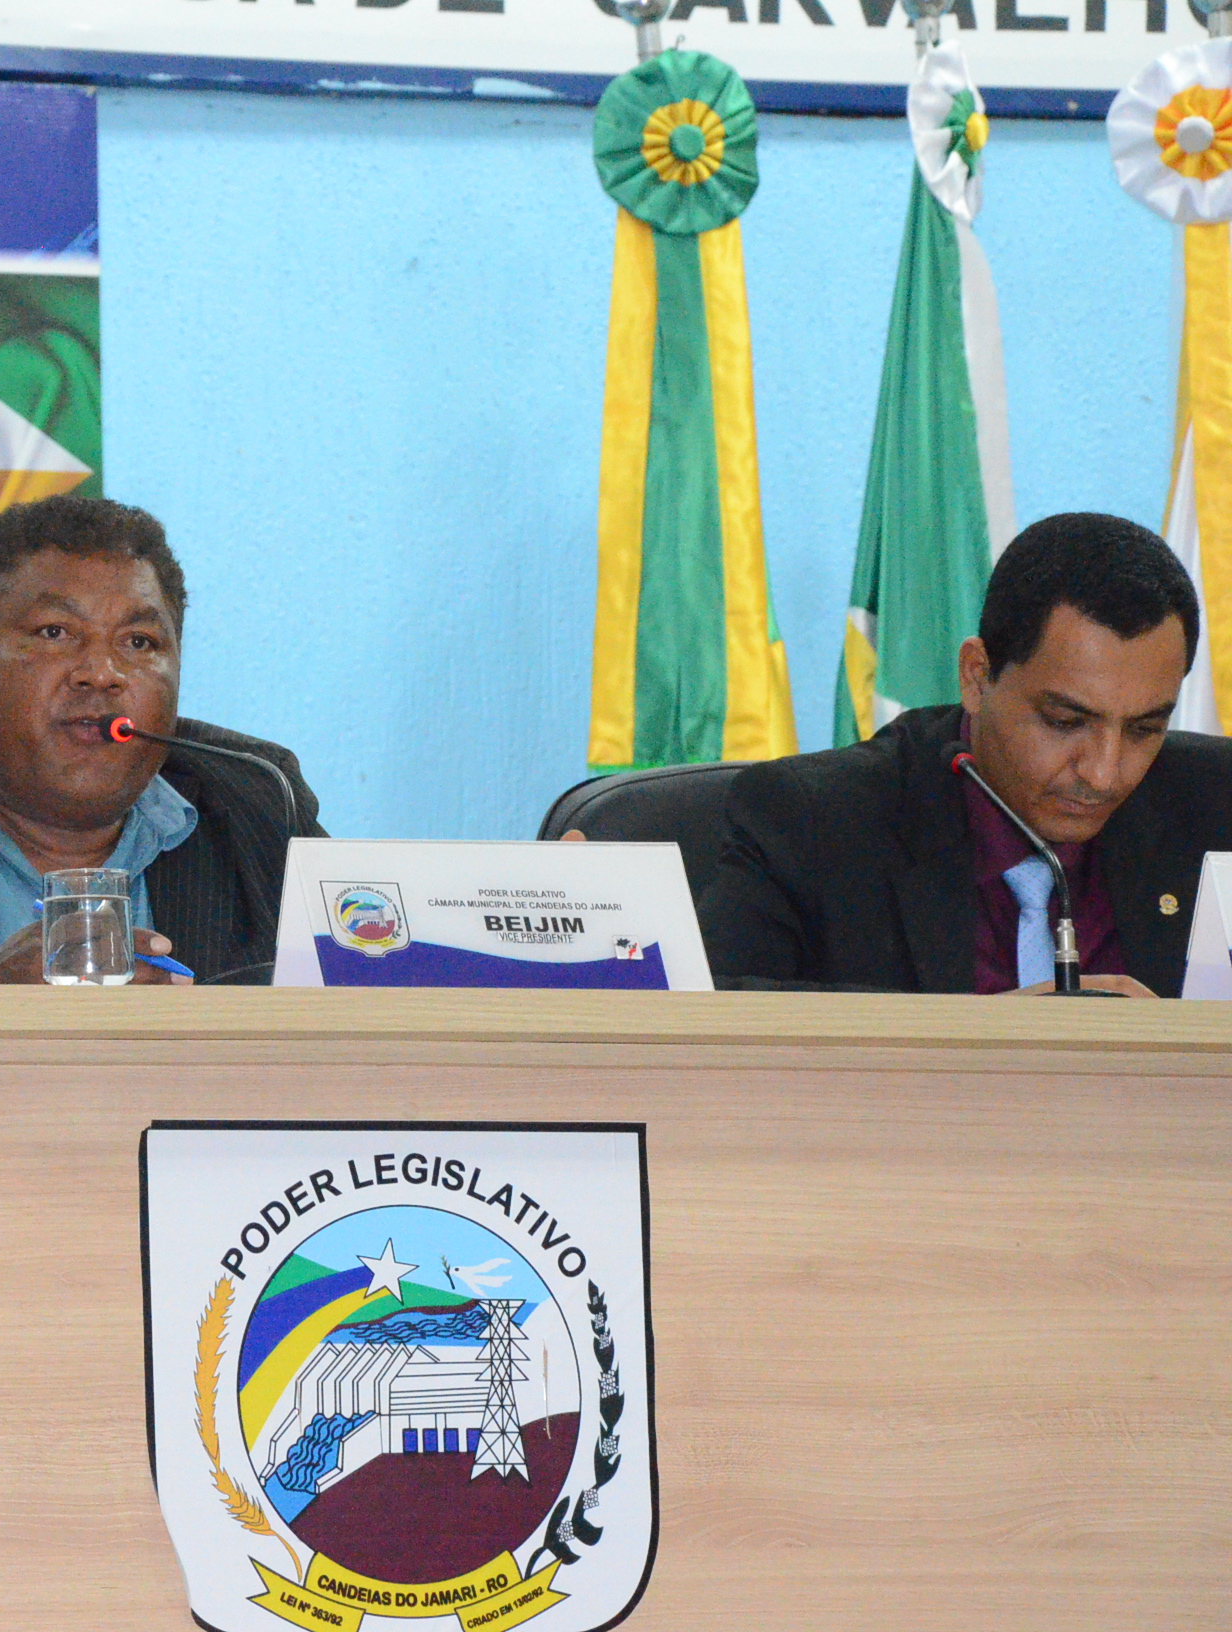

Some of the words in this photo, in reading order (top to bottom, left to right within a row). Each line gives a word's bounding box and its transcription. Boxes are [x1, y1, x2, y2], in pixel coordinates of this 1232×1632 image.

[336, 888, 352, 902] PODER
[352, 885, 393, 904] LEGISLATIVO
[478, 888, 509, 898] PODER
[511, 889, 566, 899] LEGISLATIVO
[428, 898, 466, 908] CÂMARA
[467, 900, 514, 909] MUNICIPAL
[515, 901, 527, 909] DE
[529, 901, 573, 910] CANDEIAS
[575, 902, 588, 911] DO
[589, 902, 622, 911] JAMARI
[483, 915, 585, 934] BEIJIM
[499, 932, 519, 942] VICE
[521, 933, 574, 944] PRESIDENTE
[220, 1168, 342, 1281] PODER
[347, 1152, 587, 1278] LEGISLATIVO
[317, 1574, 392, 1606] CANDEIAS
[395, 1592, 418, 1607] DO
[421, 1584, 478, 1607] JAMARI
[486, 1573, 508, 1594] RO
[279, 1591, 298, 1608] LEI
[297, 1601, 311, 1613] Nº
[311, 1606, 343, 1627] 363/92
[466, 1609, 500, 1629] CRIADO
[499, 1603, 514, 1616] EM
[513, 1586, 545, 1609] 13/02/92
